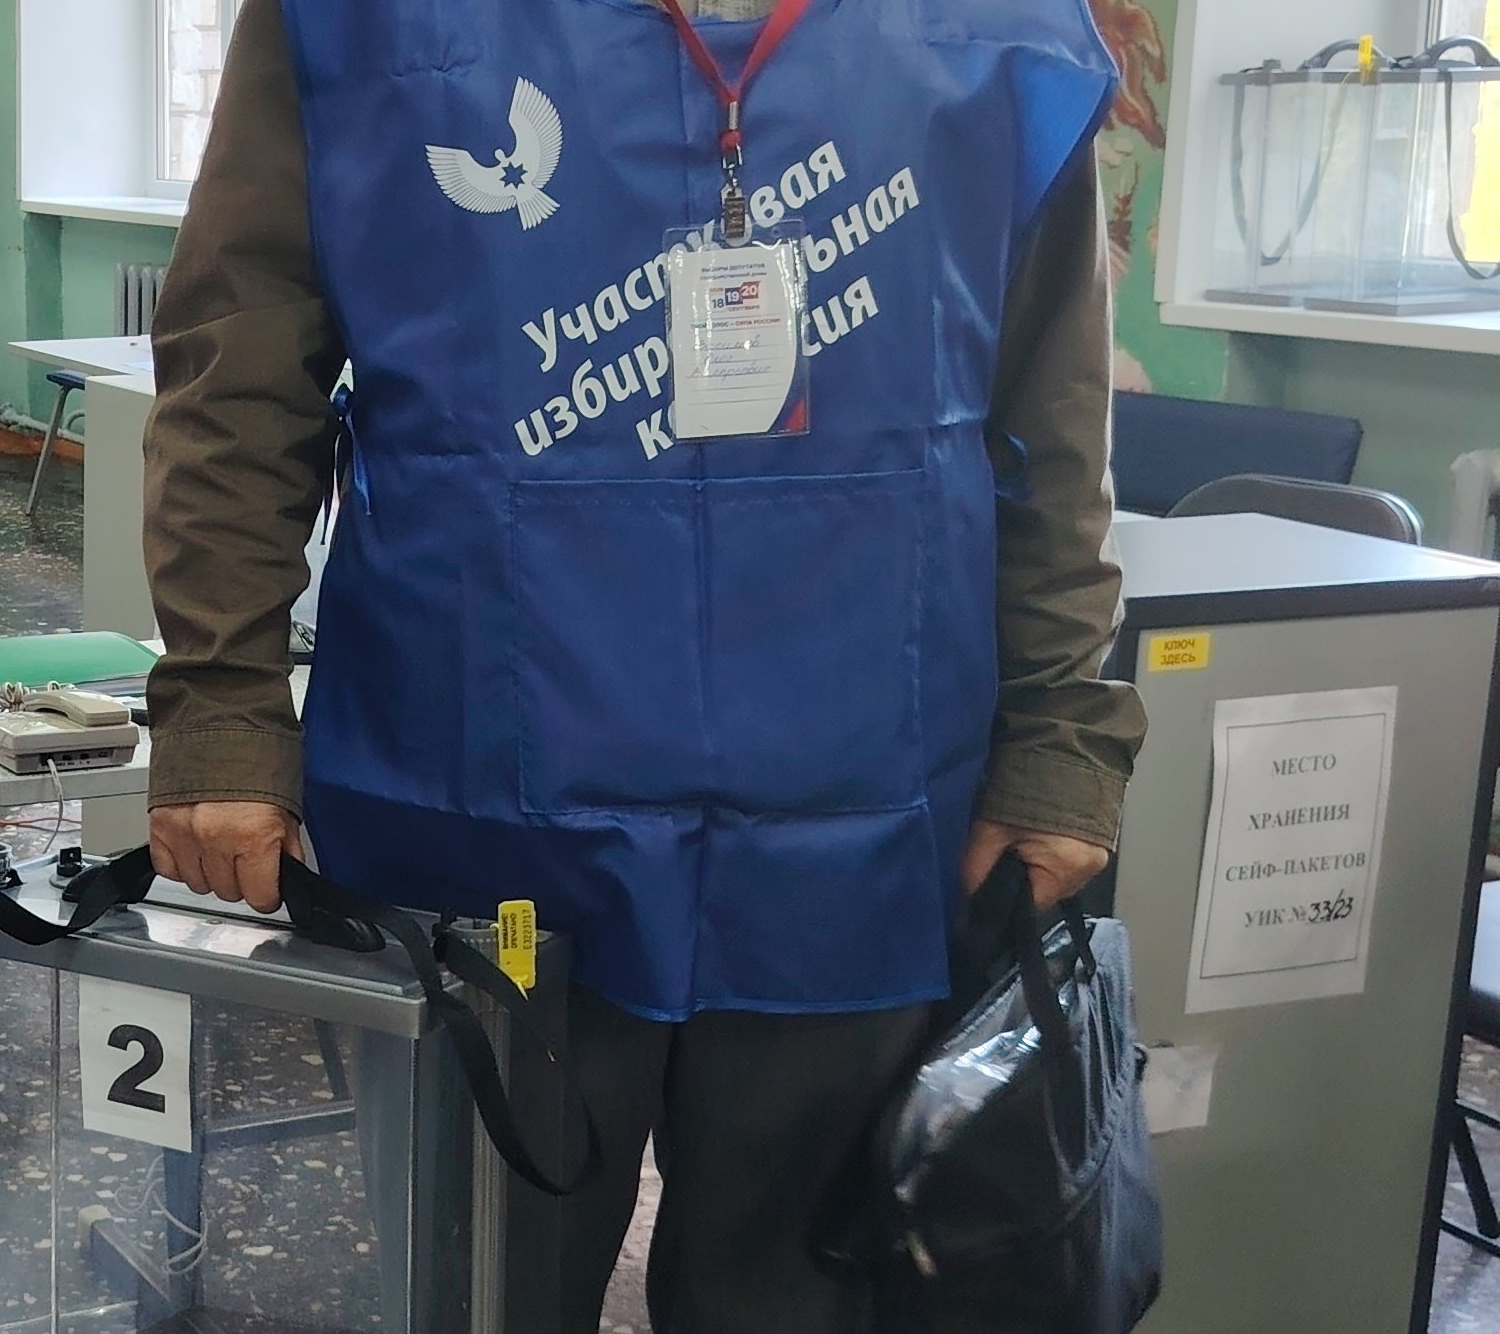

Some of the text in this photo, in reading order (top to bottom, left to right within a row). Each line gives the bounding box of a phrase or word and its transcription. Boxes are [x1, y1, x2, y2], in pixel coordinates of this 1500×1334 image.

[711, 284, 758, 309] 18 19 20
[513, 166, 921, 458] избирьная
[1163, 639, 1196, 651] КЛЮЧ
[1160, 653, 1196, 666] ЗДЕСЬ
[1271, 753, 1337, 777] МЕСТО
[1247, 803, 1351, 831] ХРАНЕНИЯ
[1225, 851, 1367, 883] СЕЙФ-ПАКЕТОВ
[107, 1023, 166, 1114] 2
